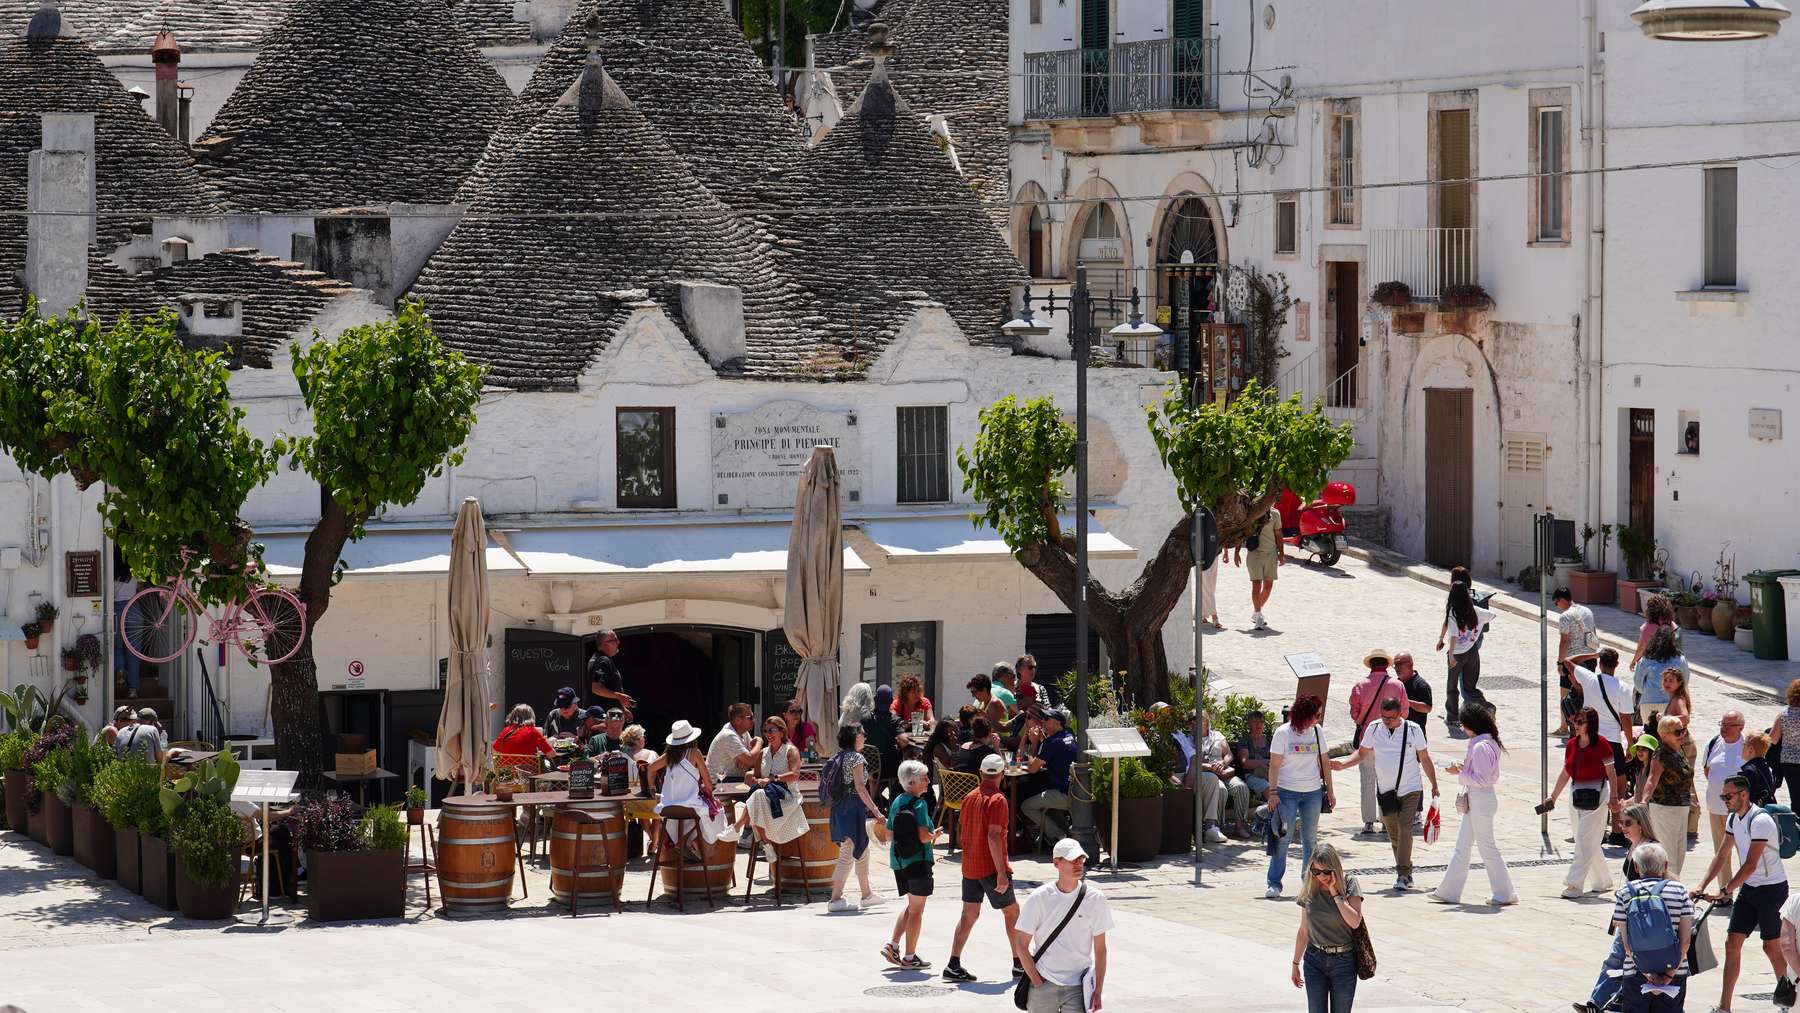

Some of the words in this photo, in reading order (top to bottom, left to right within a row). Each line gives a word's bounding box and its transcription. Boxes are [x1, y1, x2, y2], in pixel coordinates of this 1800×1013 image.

[754, 426, 770, 434] ZONA
[774, 425, 821, 434] MONUMENTALE
[735, 439, 776, 450] PRINCIPE
[781, 438, 790, 449] DI
[795, 437, 841, 449] PIEMONTE
[717, 471, 755, 479] DELIBERAZIONE
[511, 647, 553, 658] QUESTO
